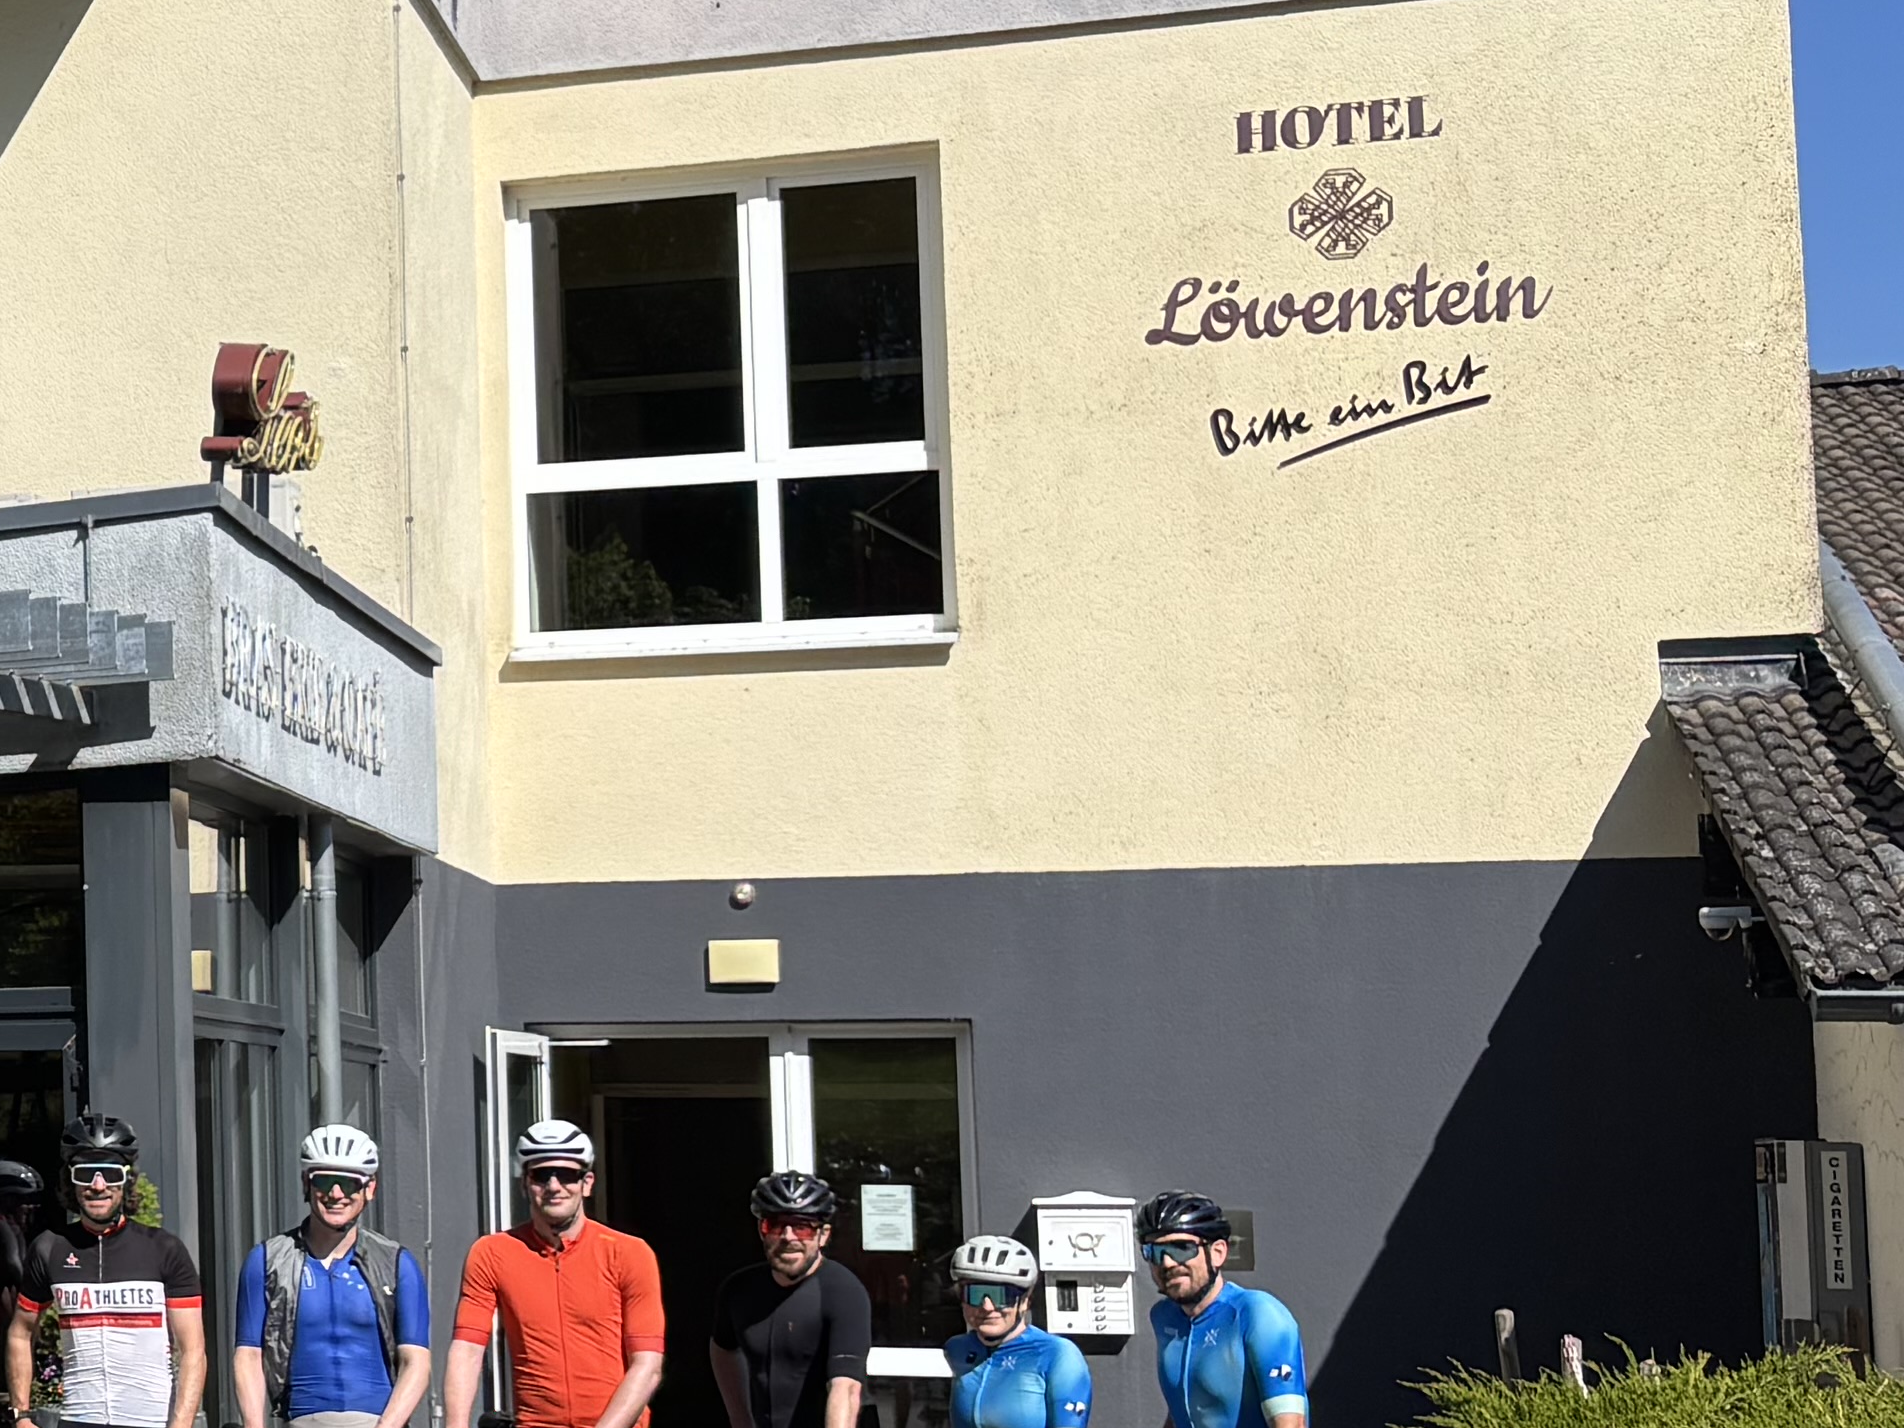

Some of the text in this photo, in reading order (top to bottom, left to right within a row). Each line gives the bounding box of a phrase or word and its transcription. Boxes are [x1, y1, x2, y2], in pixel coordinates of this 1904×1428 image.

[1234, 94, 1443, 155] HOTEL
[1144, 259, 1554, 346] Löwenstein
[1209, 354, 1490, 457] Bitte ein Bit
[1828, 1157, 1845, 1284] CIGARETTEN
